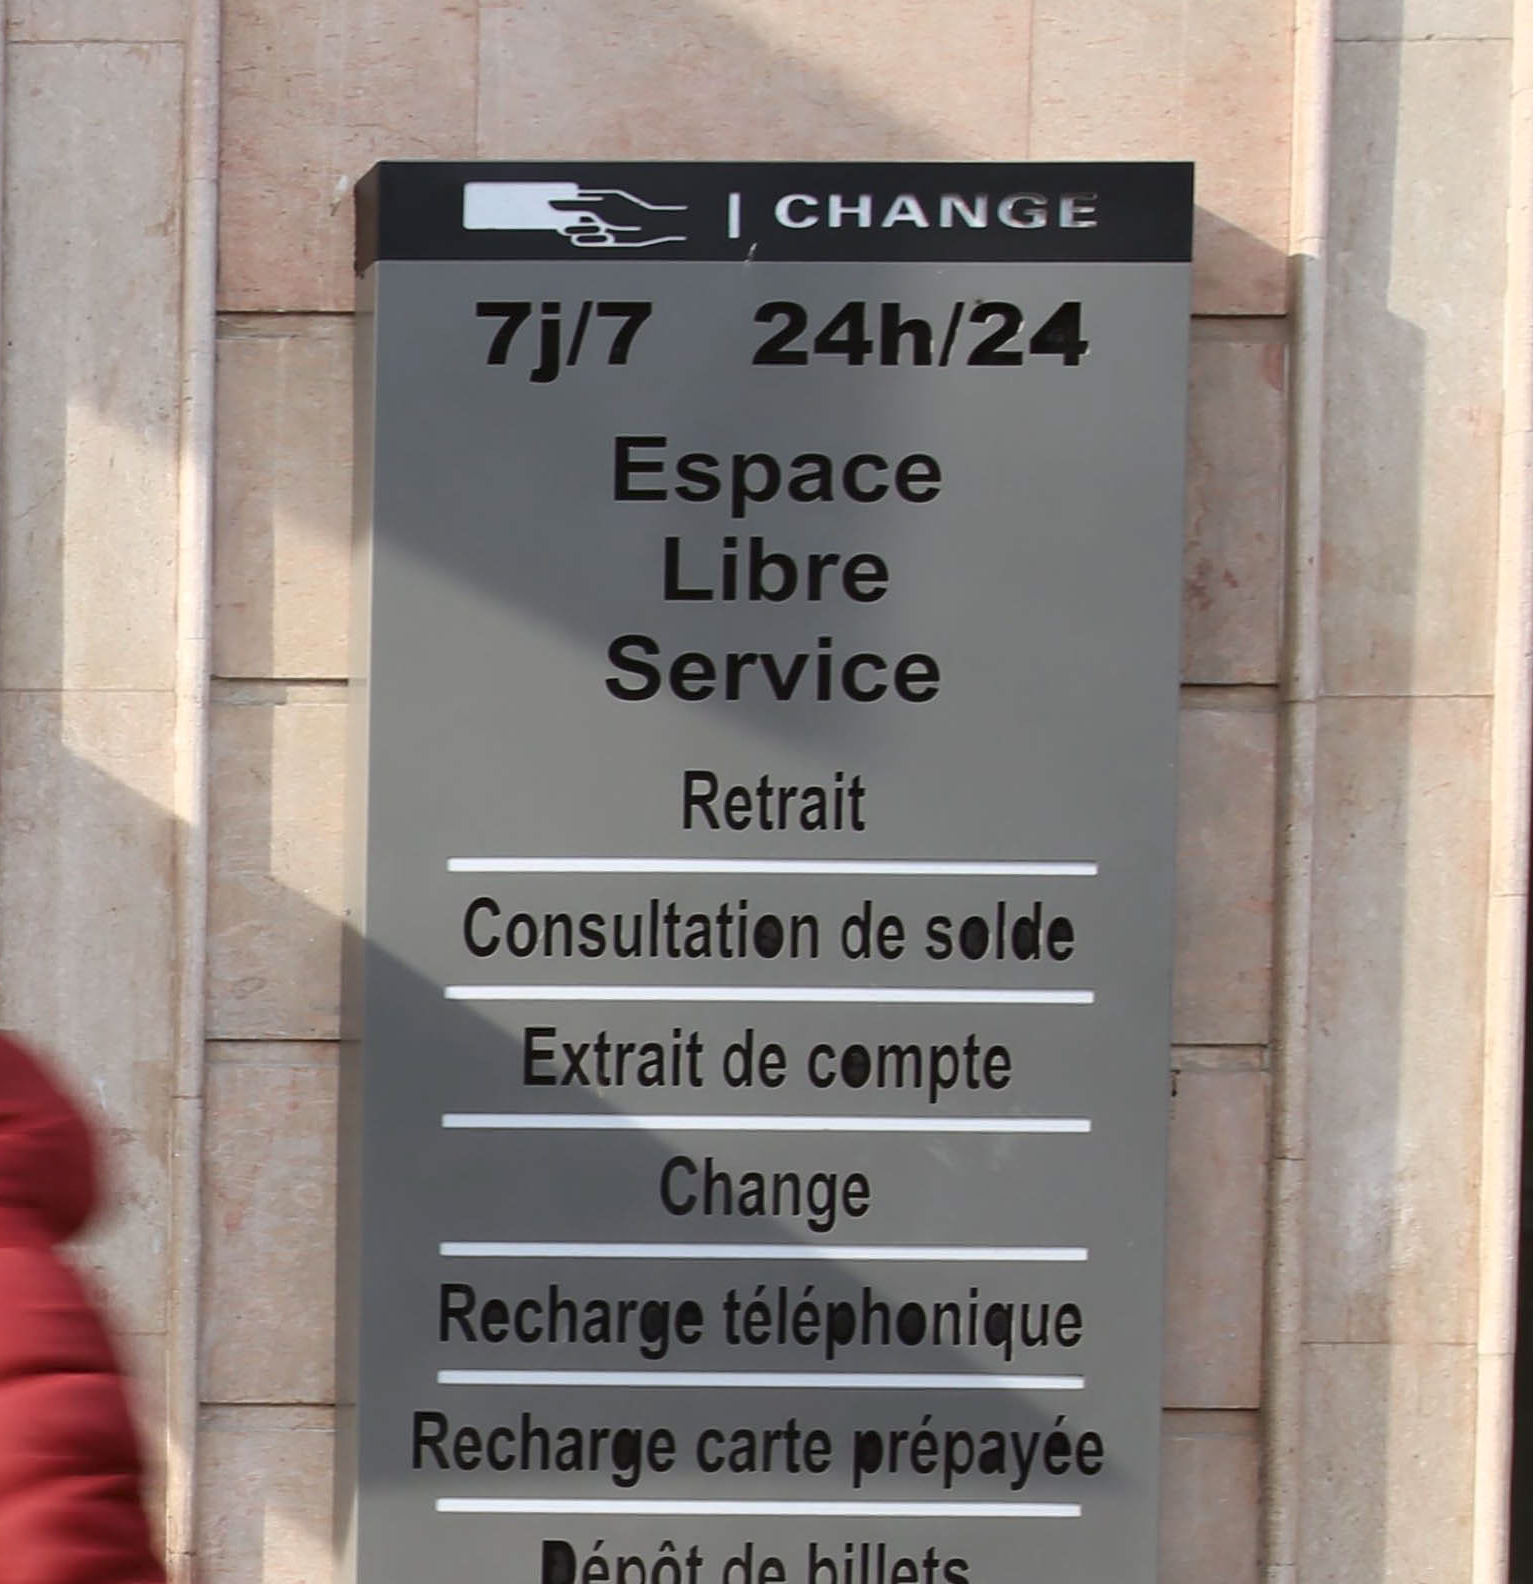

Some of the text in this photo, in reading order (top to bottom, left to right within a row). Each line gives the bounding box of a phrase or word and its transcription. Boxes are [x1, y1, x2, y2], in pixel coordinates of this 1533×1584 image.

[774, 193, 1098, 229] CHANGE
[475, 300, 1089, 384] 7j/7 24h/24
[613, 435, 942, 519] Espace
[663, 535, 889, 603] Libre
[605, 634, 940, 703] Service
[683, 770, 866, 832] Retrait
[463, 896, 1075, 962] Consultation de solde
[522, 1026, 1012, 1105] Extrait de compte
[659, 1155, 870, 1233] Change
[438, 1282, 1083, 1362] Recharge téléphonique
[411, 1410, 1104, 1491] Recharge carte prépayée
